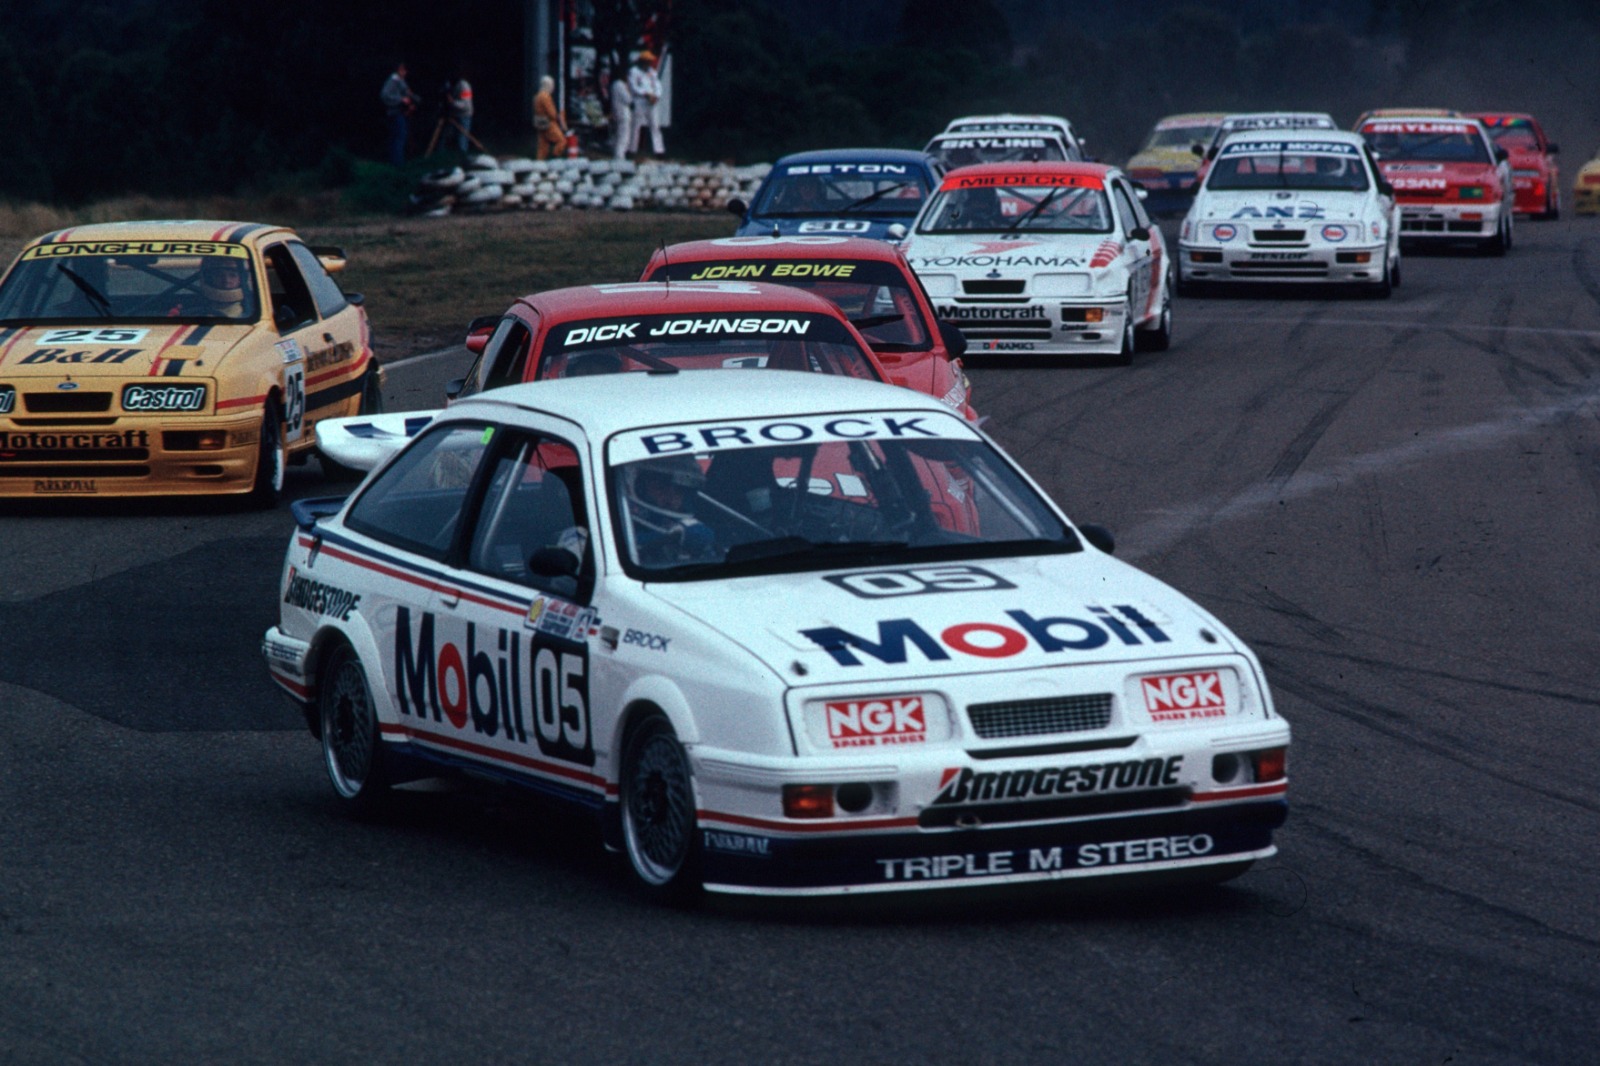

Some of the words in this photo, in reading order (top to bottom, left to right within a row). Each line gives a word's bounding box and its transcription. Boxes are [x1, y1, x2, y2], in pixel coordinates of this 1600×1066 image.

[941, 139, 1045, 149] SKYLINE
[1230, 143, 1282, 152] ALLAN
[1287, 143, 1352, 152] MOFFAT
[788, 165, 906, 175] SETON
[960, 176, 1084, 187] MIEDECKE
[34, 243, 243, 257] LONGHURST
[920, 255, 1081, 268] YOKOHAMA
[691, 265, 766, 280] JOHN
[771, 264, 856, 277] BOWE
[938, 305, 1045, 319] Motorcraft
[45, 330, 138, 342] 25
[563, 322, 641, 346] DICK
[650, 318, 810, 336] JOHNSON
[15, 349, 146, 364] B&H
[122, 386, 205, 410] Castrol
[286, 372, 305, 433] 25
[641, 417, 939, 454] BROCK
[284, 566, 362, 622] BRIDGESTONE
[842, 568, 990, 595] 05
[623, 628, 671, 652] BROCK
[797, 605, 1172, 666] Mobil
[396, 605, 527, 744] Mobil
[533, 648, 587, 750] 05
[1143, 673, 1222, 711] NGK
[828, 699, 922, 736] NGK
[934, 757, 1185, 806] BRIDGESTONE
[876, 852, 1013, 880] TRIPLE
[1029, 846, 1063, 870] M
[1078, 833, 1215, 865] STEREO
